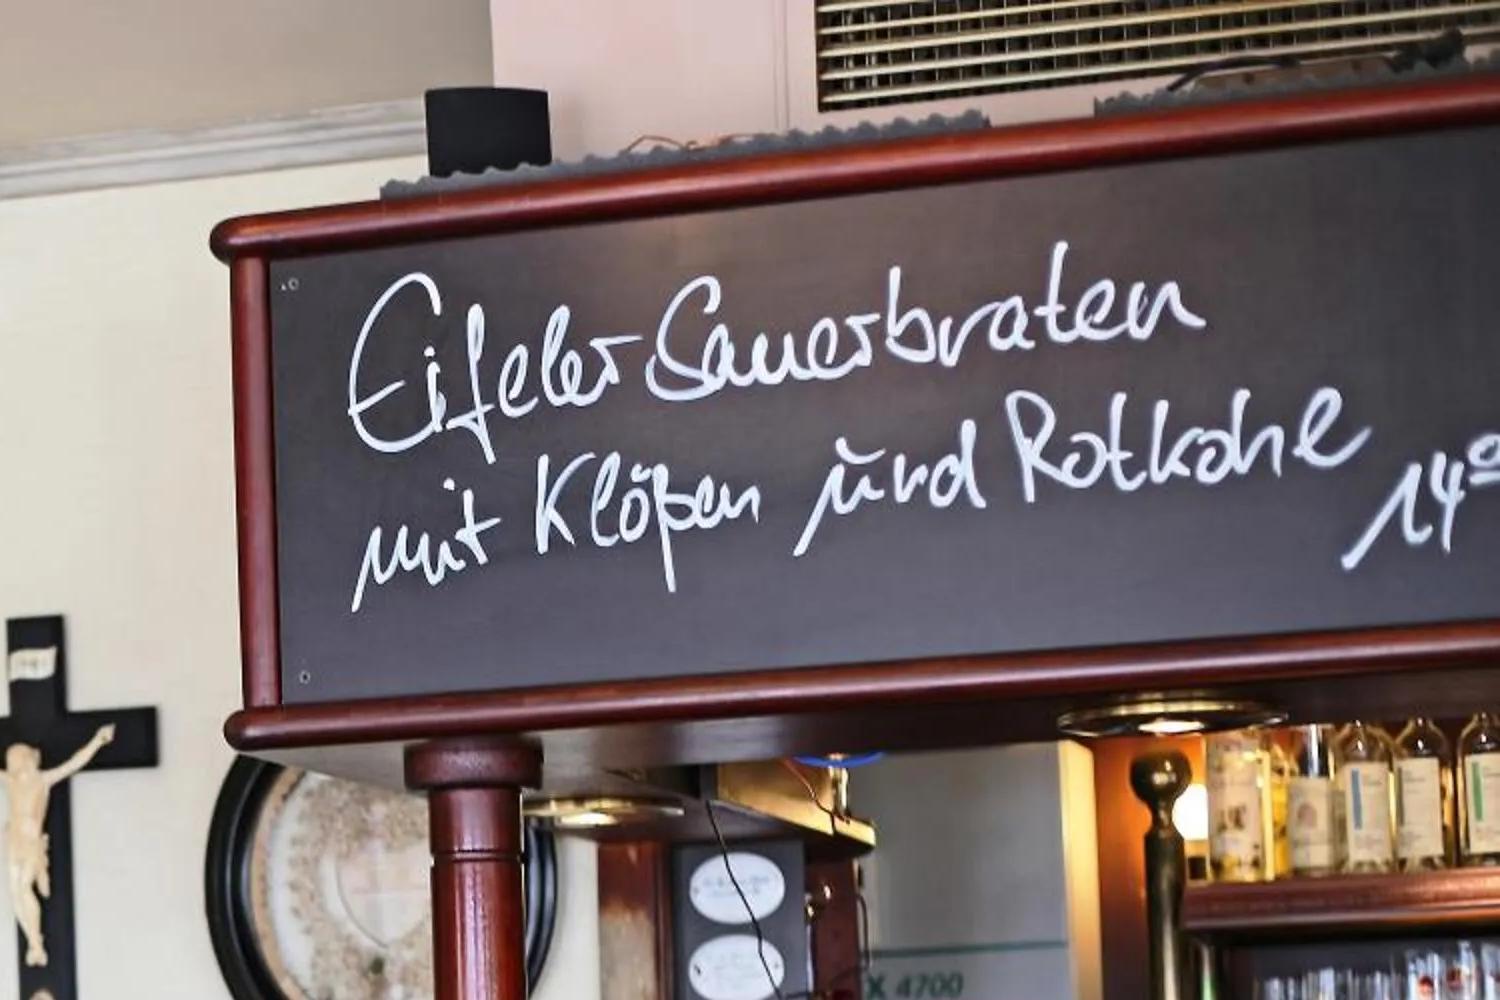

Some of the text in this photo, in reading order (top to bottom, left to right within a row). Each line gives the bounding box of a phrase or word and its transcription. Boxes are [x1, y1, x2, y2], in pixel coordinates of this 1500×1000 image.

[348, 240, 1207, 465] Eifeler Sauerbraten
[350, 477, 501, 613] mit
[536, 450, 761, 593] Klößen
[793, 418, 987, 557] und
[895, 971, 965, 999] 4700
